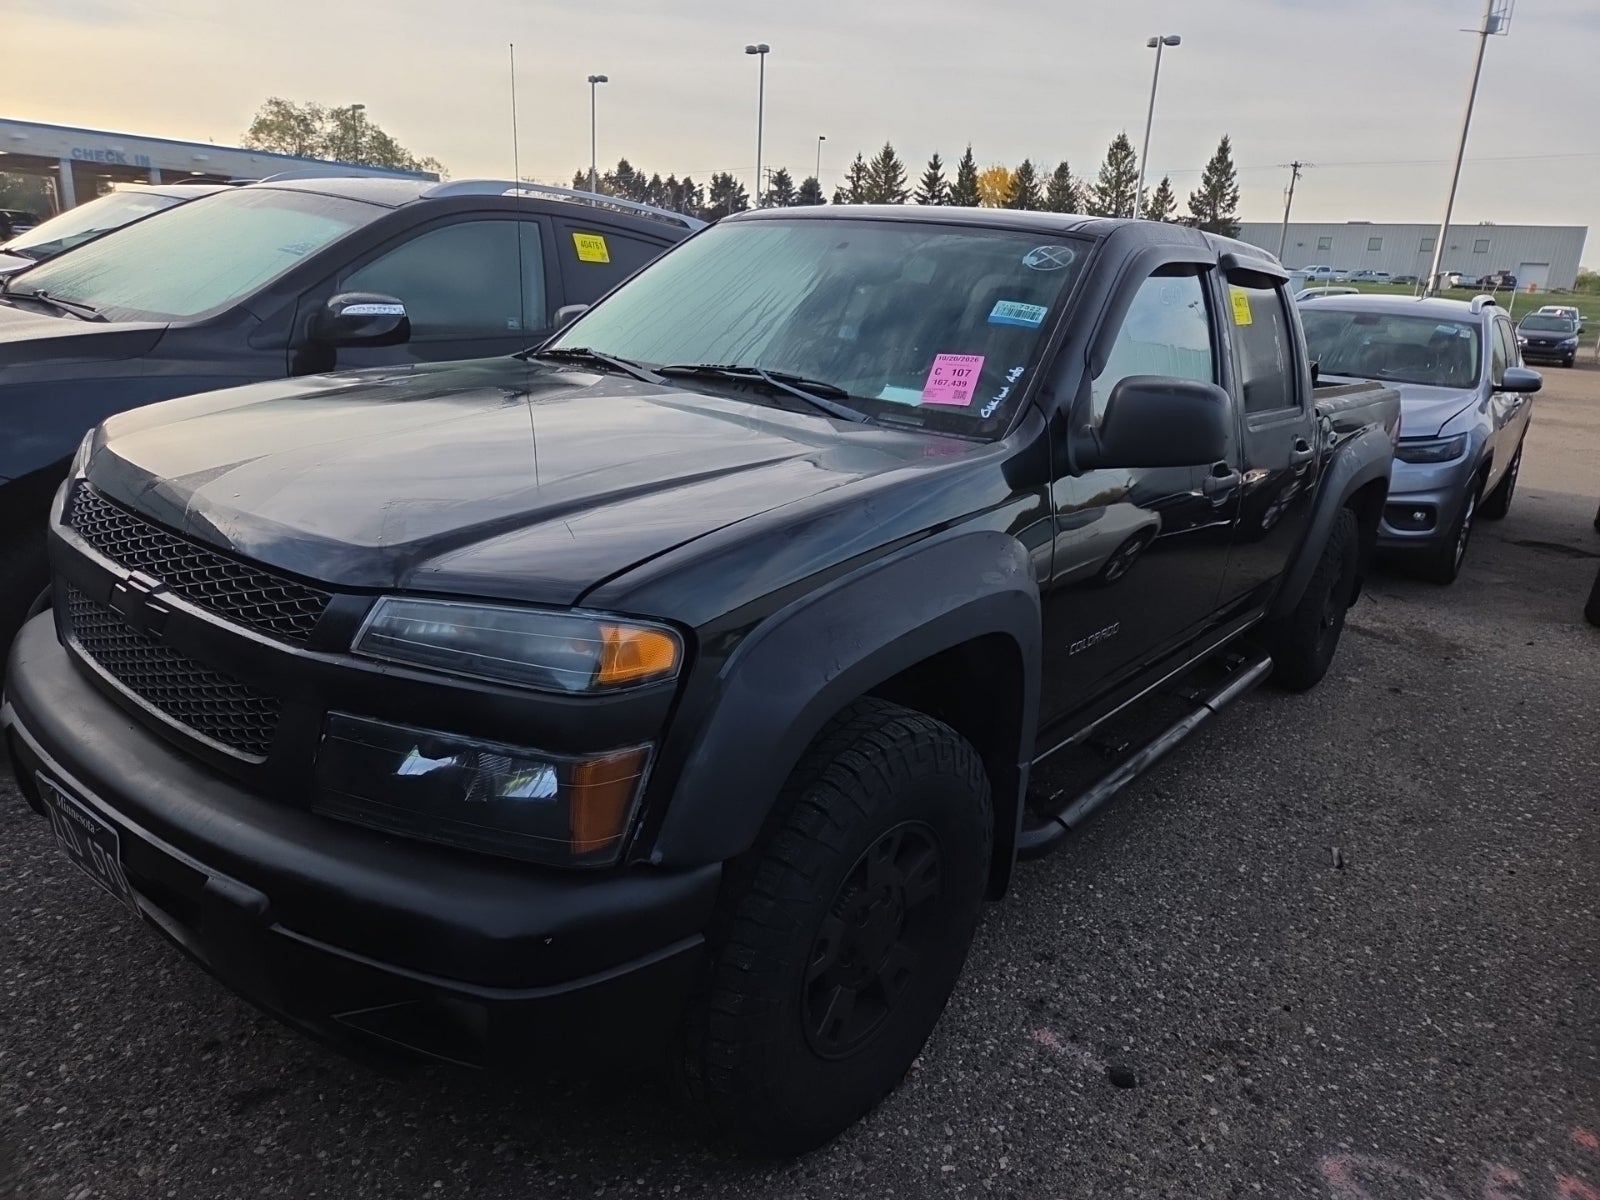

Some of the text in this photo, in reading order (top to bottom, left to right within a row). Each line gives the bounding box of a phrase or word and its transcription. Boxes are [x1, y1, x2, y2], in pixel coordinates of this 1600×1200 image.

[71, 147, 152, 167] CHECK IN
[934, 367, 972, 378] C 107
[1069, 621, 1121, 655] COLORADO
[56, 793, 96, 834] Minnesota
